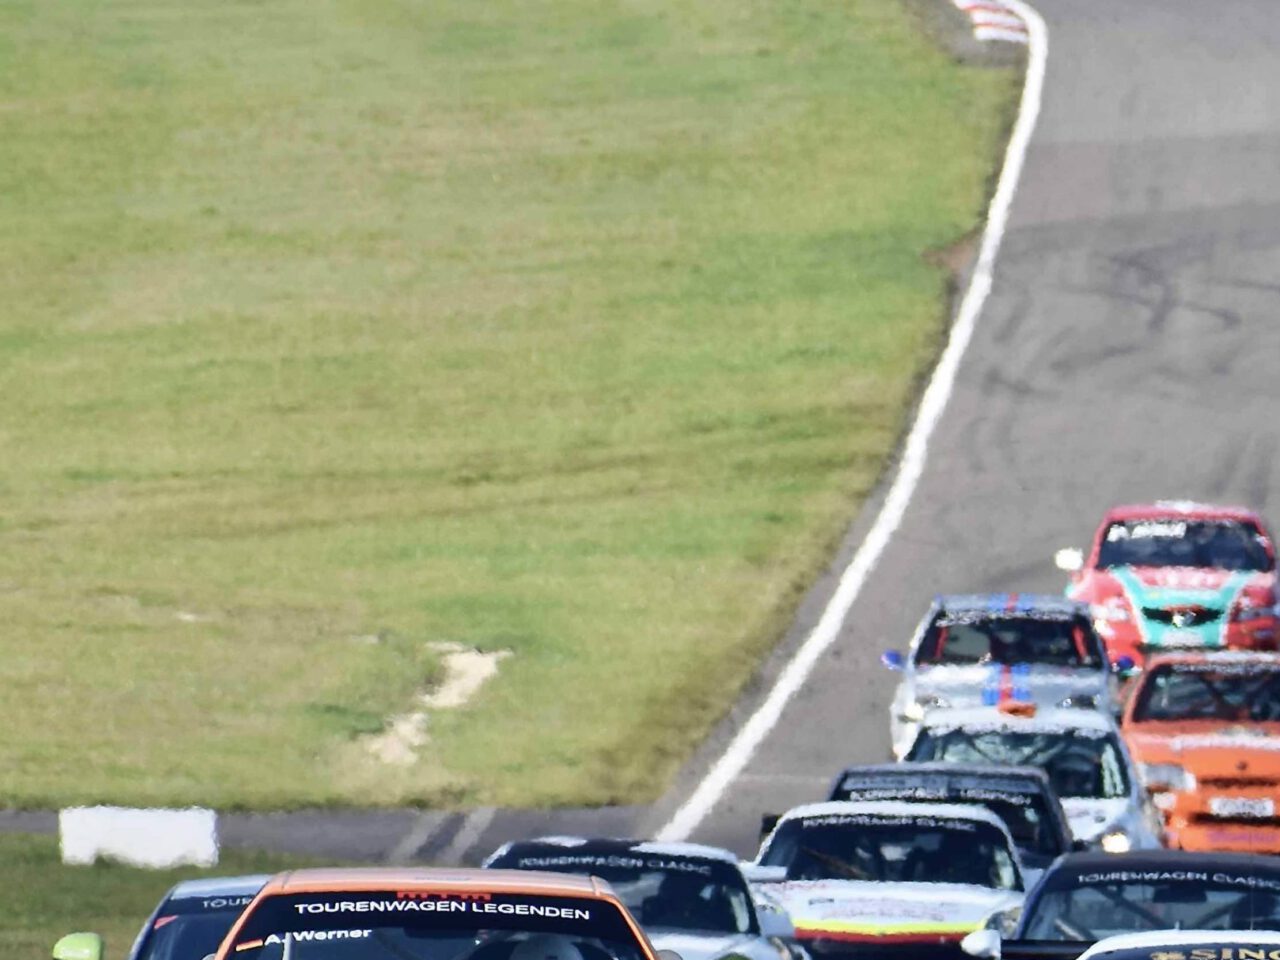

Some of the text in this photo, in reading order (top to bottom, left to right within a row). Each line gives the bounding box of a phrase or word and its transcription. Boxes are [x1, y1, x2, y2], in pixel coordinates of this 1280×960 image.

[1078, 871, 1207, 883] TOURENWAGEN
[294, 900, 590, 921] TOURENWAGEN LEGENDEN
[293, 927, 372, 942] Werner
